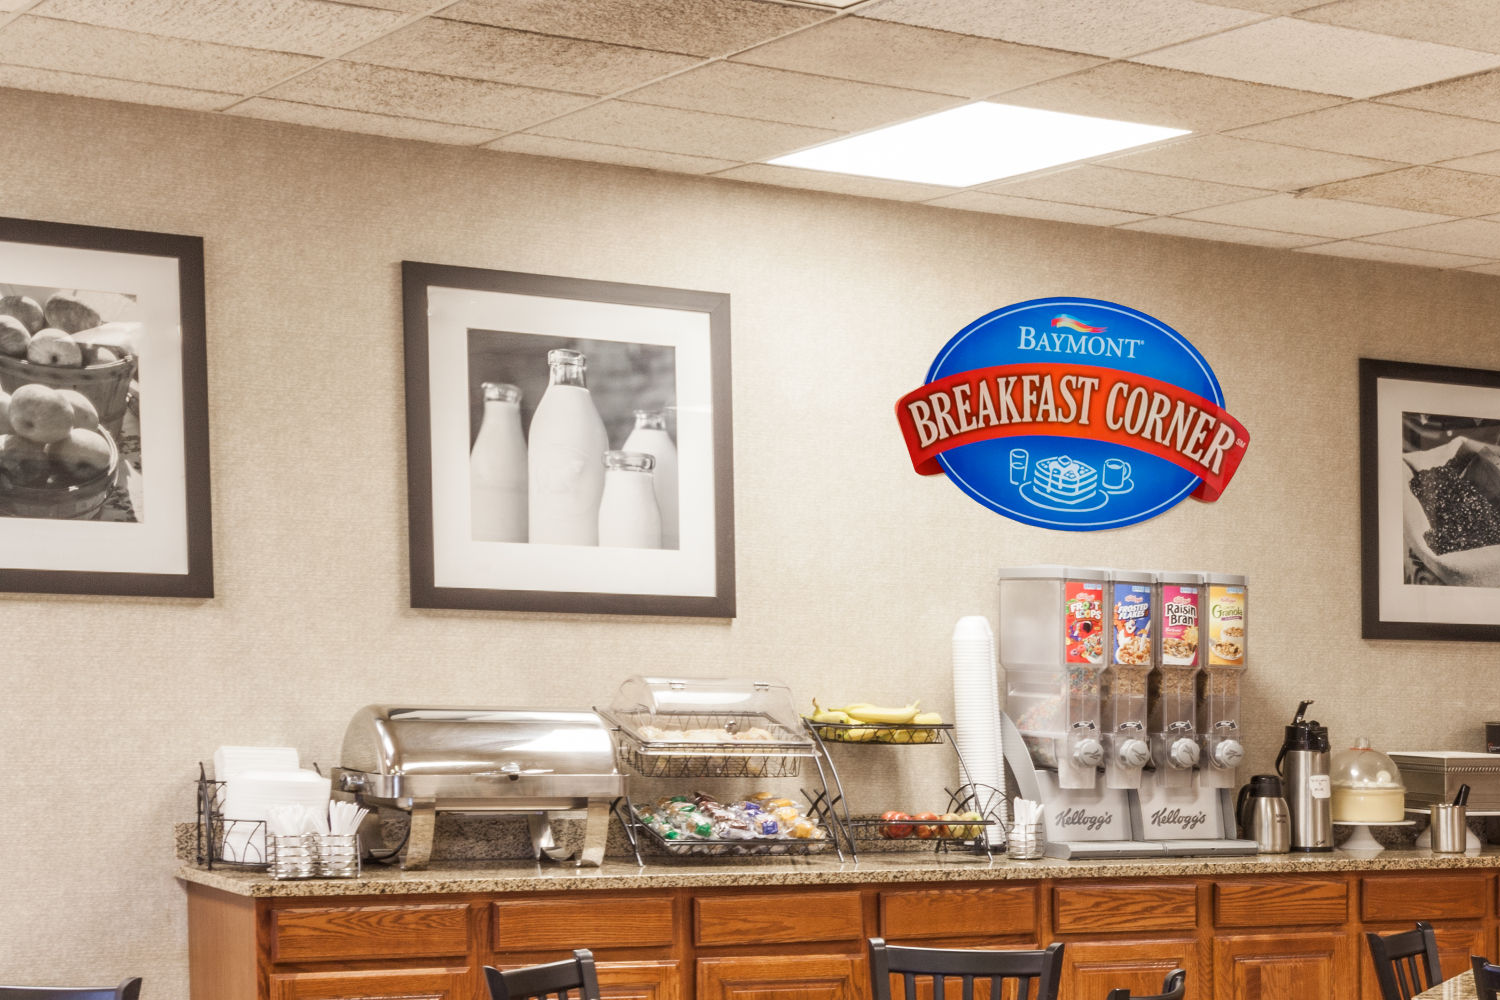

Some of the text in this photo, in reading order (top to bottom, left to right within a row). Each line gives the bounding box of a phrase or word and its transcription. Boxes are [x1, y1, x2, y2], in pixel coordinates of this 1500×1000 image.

[1017, 326, 1140, 358] BAYMONT
[908, 374, 1236, 475] BREAKFAST CORNER
[1070, 601, 1100, 612] FROOT
[1166, 603, 1196, 616] Raisin
[1212, 604, 1243, 619] Granola
[1170, 614, 1194, 625] Bran
[1055, 808, 1113, 831] Kellogg's
[1151, 808, 1207, 830] Kellogg's
